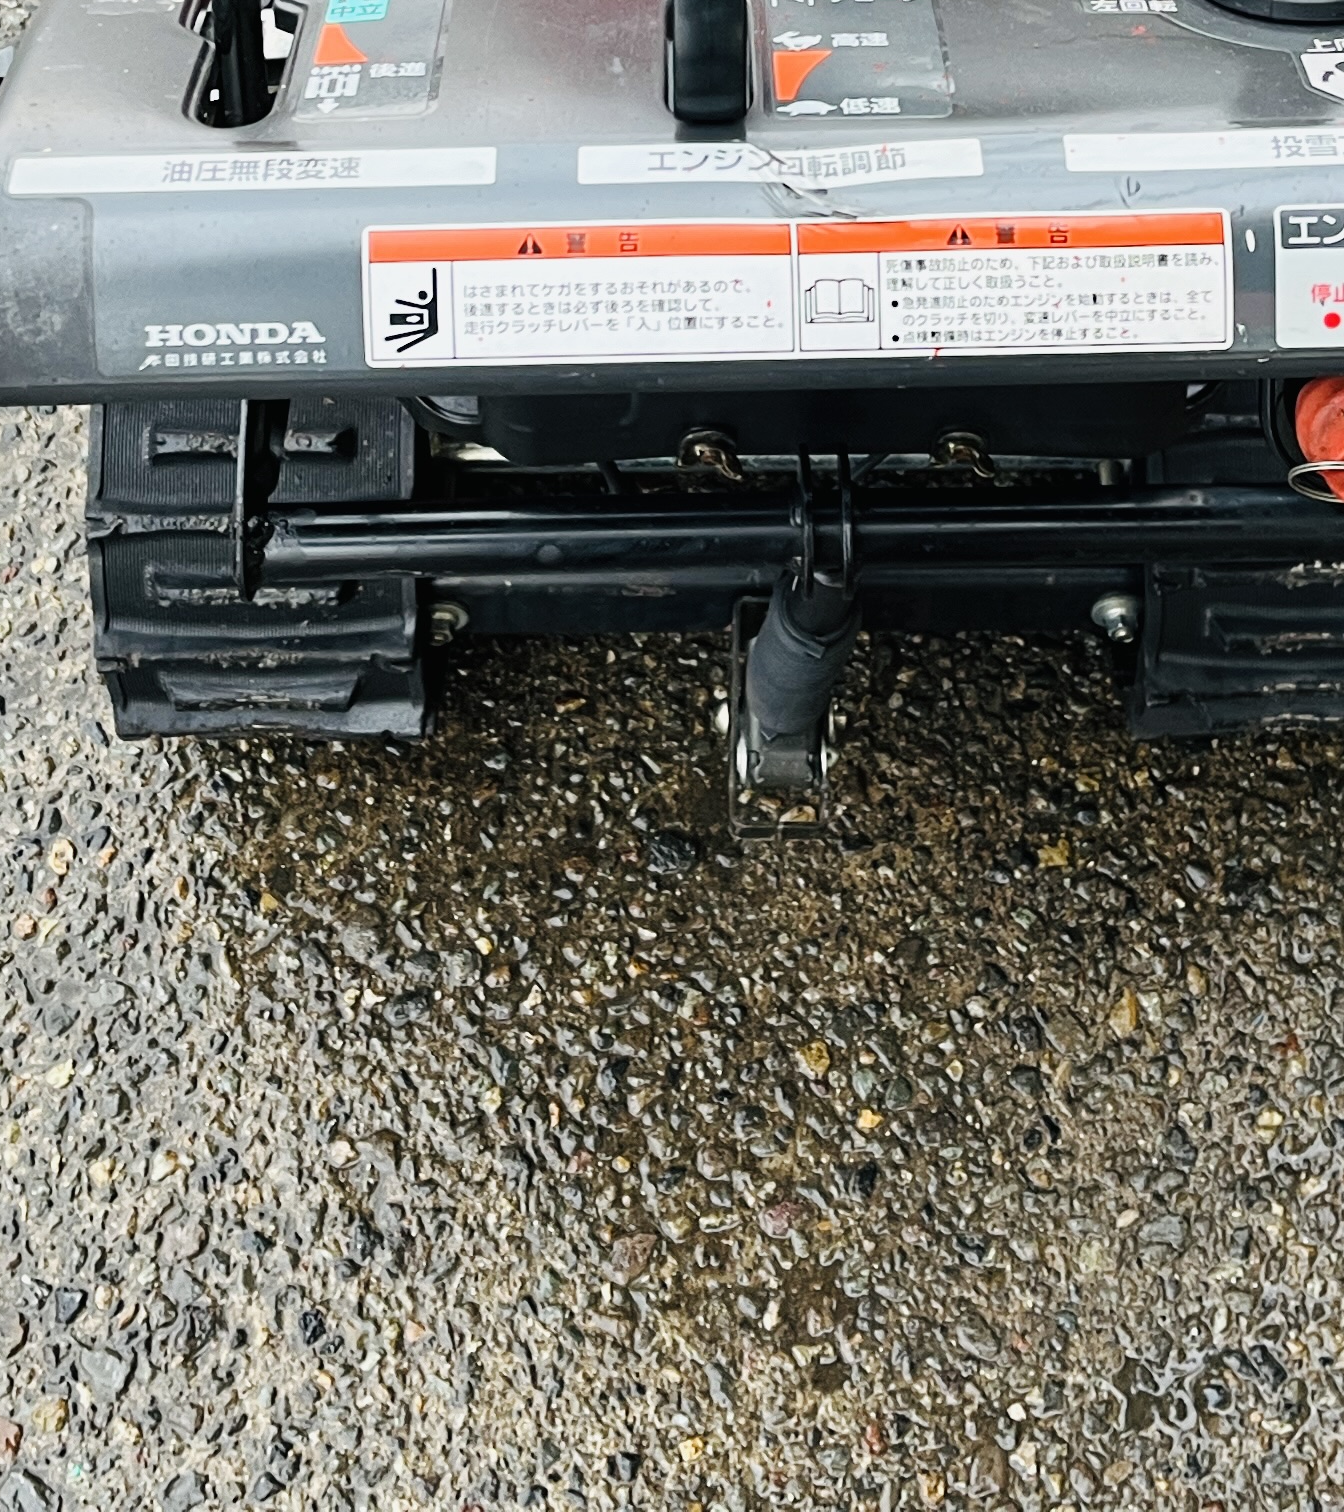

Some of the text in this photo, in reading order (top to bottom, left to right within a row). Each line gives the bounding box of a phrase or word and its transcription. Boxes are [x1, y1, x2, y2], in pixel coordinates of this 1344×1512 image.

[330, 3, 383, 18] 中立
[830, 32, 890, 47] 高速
[839, 97, 902, 115] 低速
[161, 156, 362, 184] 油圧無段変速
[647, 146, 907, 179] エンジン回転調節
[144, 321, 327, 347] HONDA
